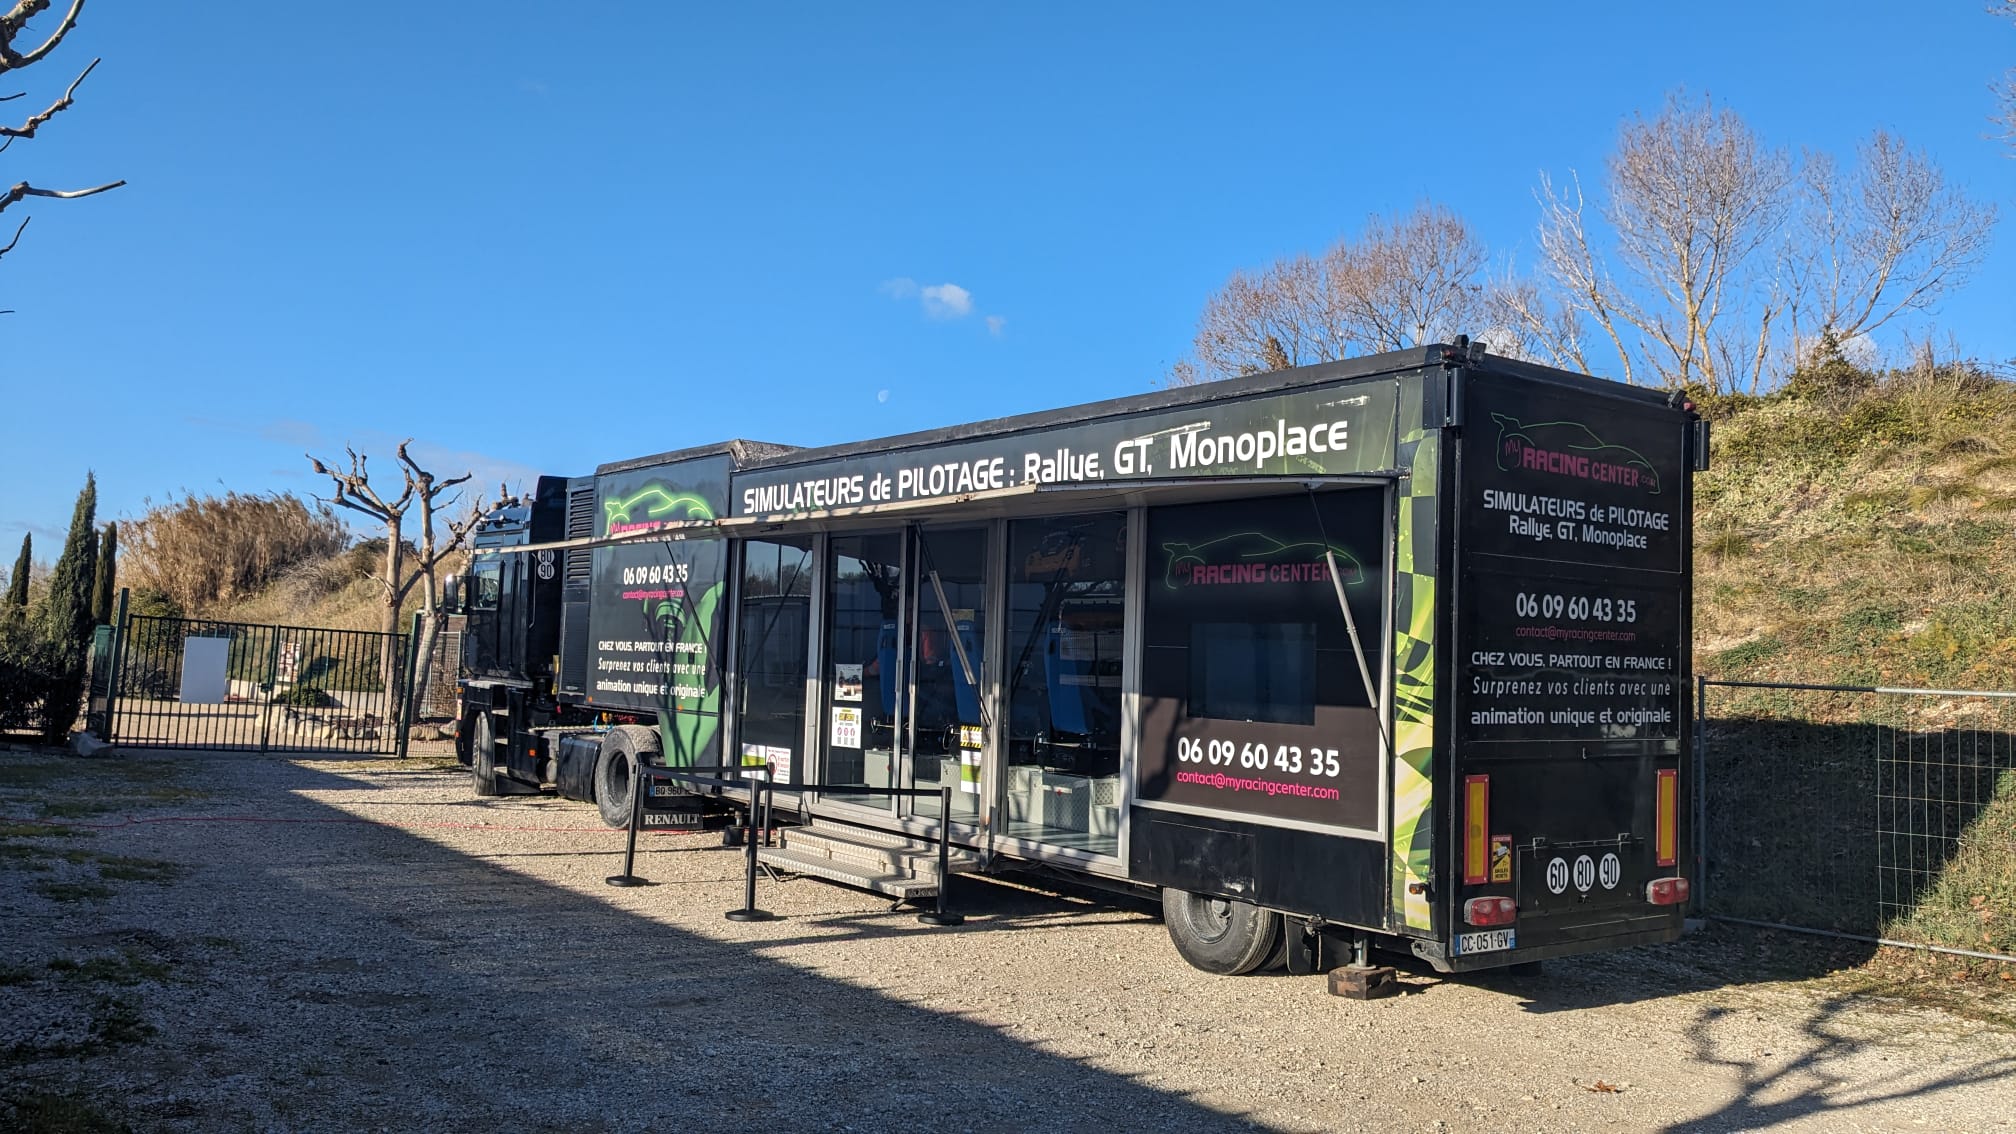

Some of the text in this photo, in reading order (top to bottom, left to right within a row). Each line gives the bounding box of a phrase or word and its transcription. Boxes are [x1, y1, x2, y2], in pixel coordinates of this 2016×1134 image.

[743, 475, 864, 514] SIMULATEURS
[869, 472, 891, 501] de
[898, 457, 1005, 499] PILOTAGE
[1113, 437, 1154, 476] GT,
[1169, 419, 1348, 469] Monoplace
[1523, 447, 1589, 479] RACING
[1591, 461, 1639, 488] CENTER
[1483, 489, 1669, 532] SIMULATEURS de PILOTAGE
[1509, 514, 1648, 550] Rallye, GT, Monoplace
[541, 564, 552, 578] 90
[623, 567, 635, 585] 06
[636, 566, 648, 585] 09
[649, 565, 661, 584] 60
[662, 564, 674, 583] 43
[1193, 563, 1266, 585] RACING
[1270, 562, 1333, 583] CENTER
[1515, 592, 1636, 623] 06 09 60 43 35
[1515, 625, 1636, 643] contact@myracingcenter.com
[598, 640, 614, 651] CHEZ
[634, 641, 664, 653] PARTOUT
[597, 657, 706, 676] Surprenez vos clients avec une
[1471, 651, 1505, 666] CHEZ
[1549, 653, 1602, 668] PARTOUT
[1605, 656, 1620, 669] EN
[1623, 656, 1665, 670] FRANCE
[596, 679, 706, 700] animation unique et originale
[1473, 676, 1671, 698] Surprenez vos clients avec une
[1471, 707, 1671, 727] animation unique et originale
[1177, 737, 1340, 777] 06 09 60 43 35
[1176, 770, 1340, 800] contact@myracingcenter.com
[644, 813, 700, 825] RENAULT
[1549, 857, 1617, 890] 60 80 90
[1461, 931, 1509, 952] CC-051-GV
